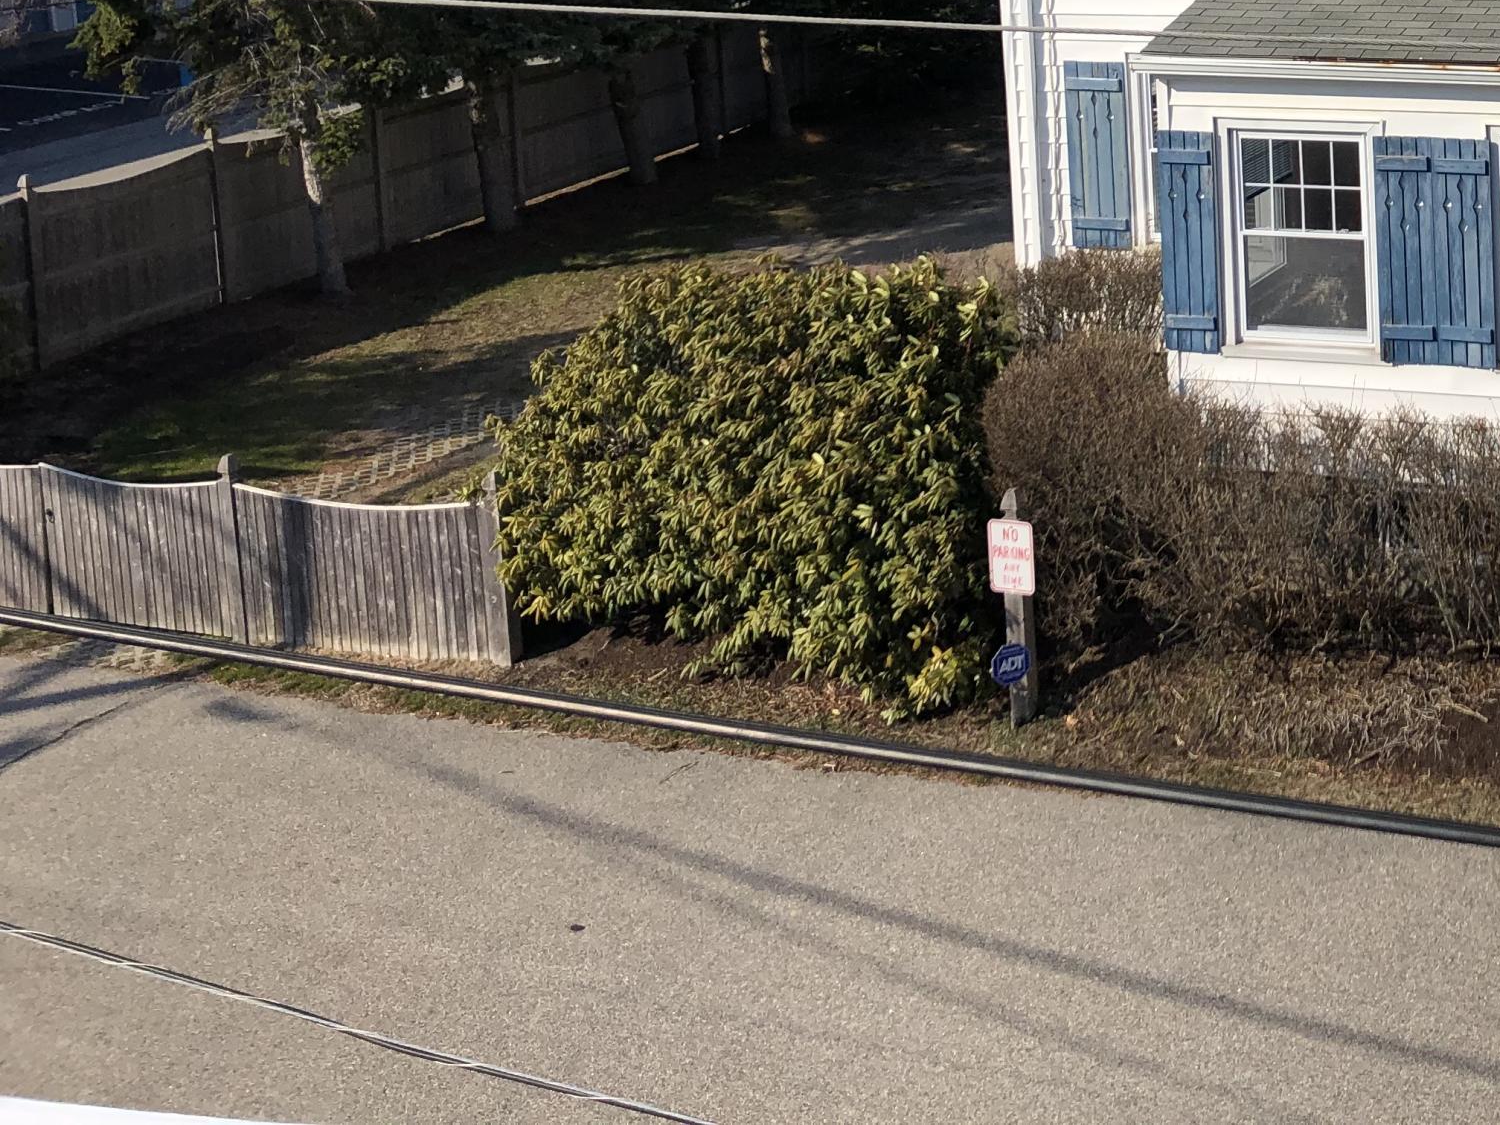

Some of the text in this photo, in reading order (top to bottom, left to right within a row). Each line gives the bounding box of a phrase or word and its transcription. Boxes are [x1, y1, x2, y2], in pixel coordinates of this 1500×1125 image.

[1003, 527, 1020, 543] NO
[992, 544, 1031, 561] PARKING
[999, 654, 1025, 674] ADT
